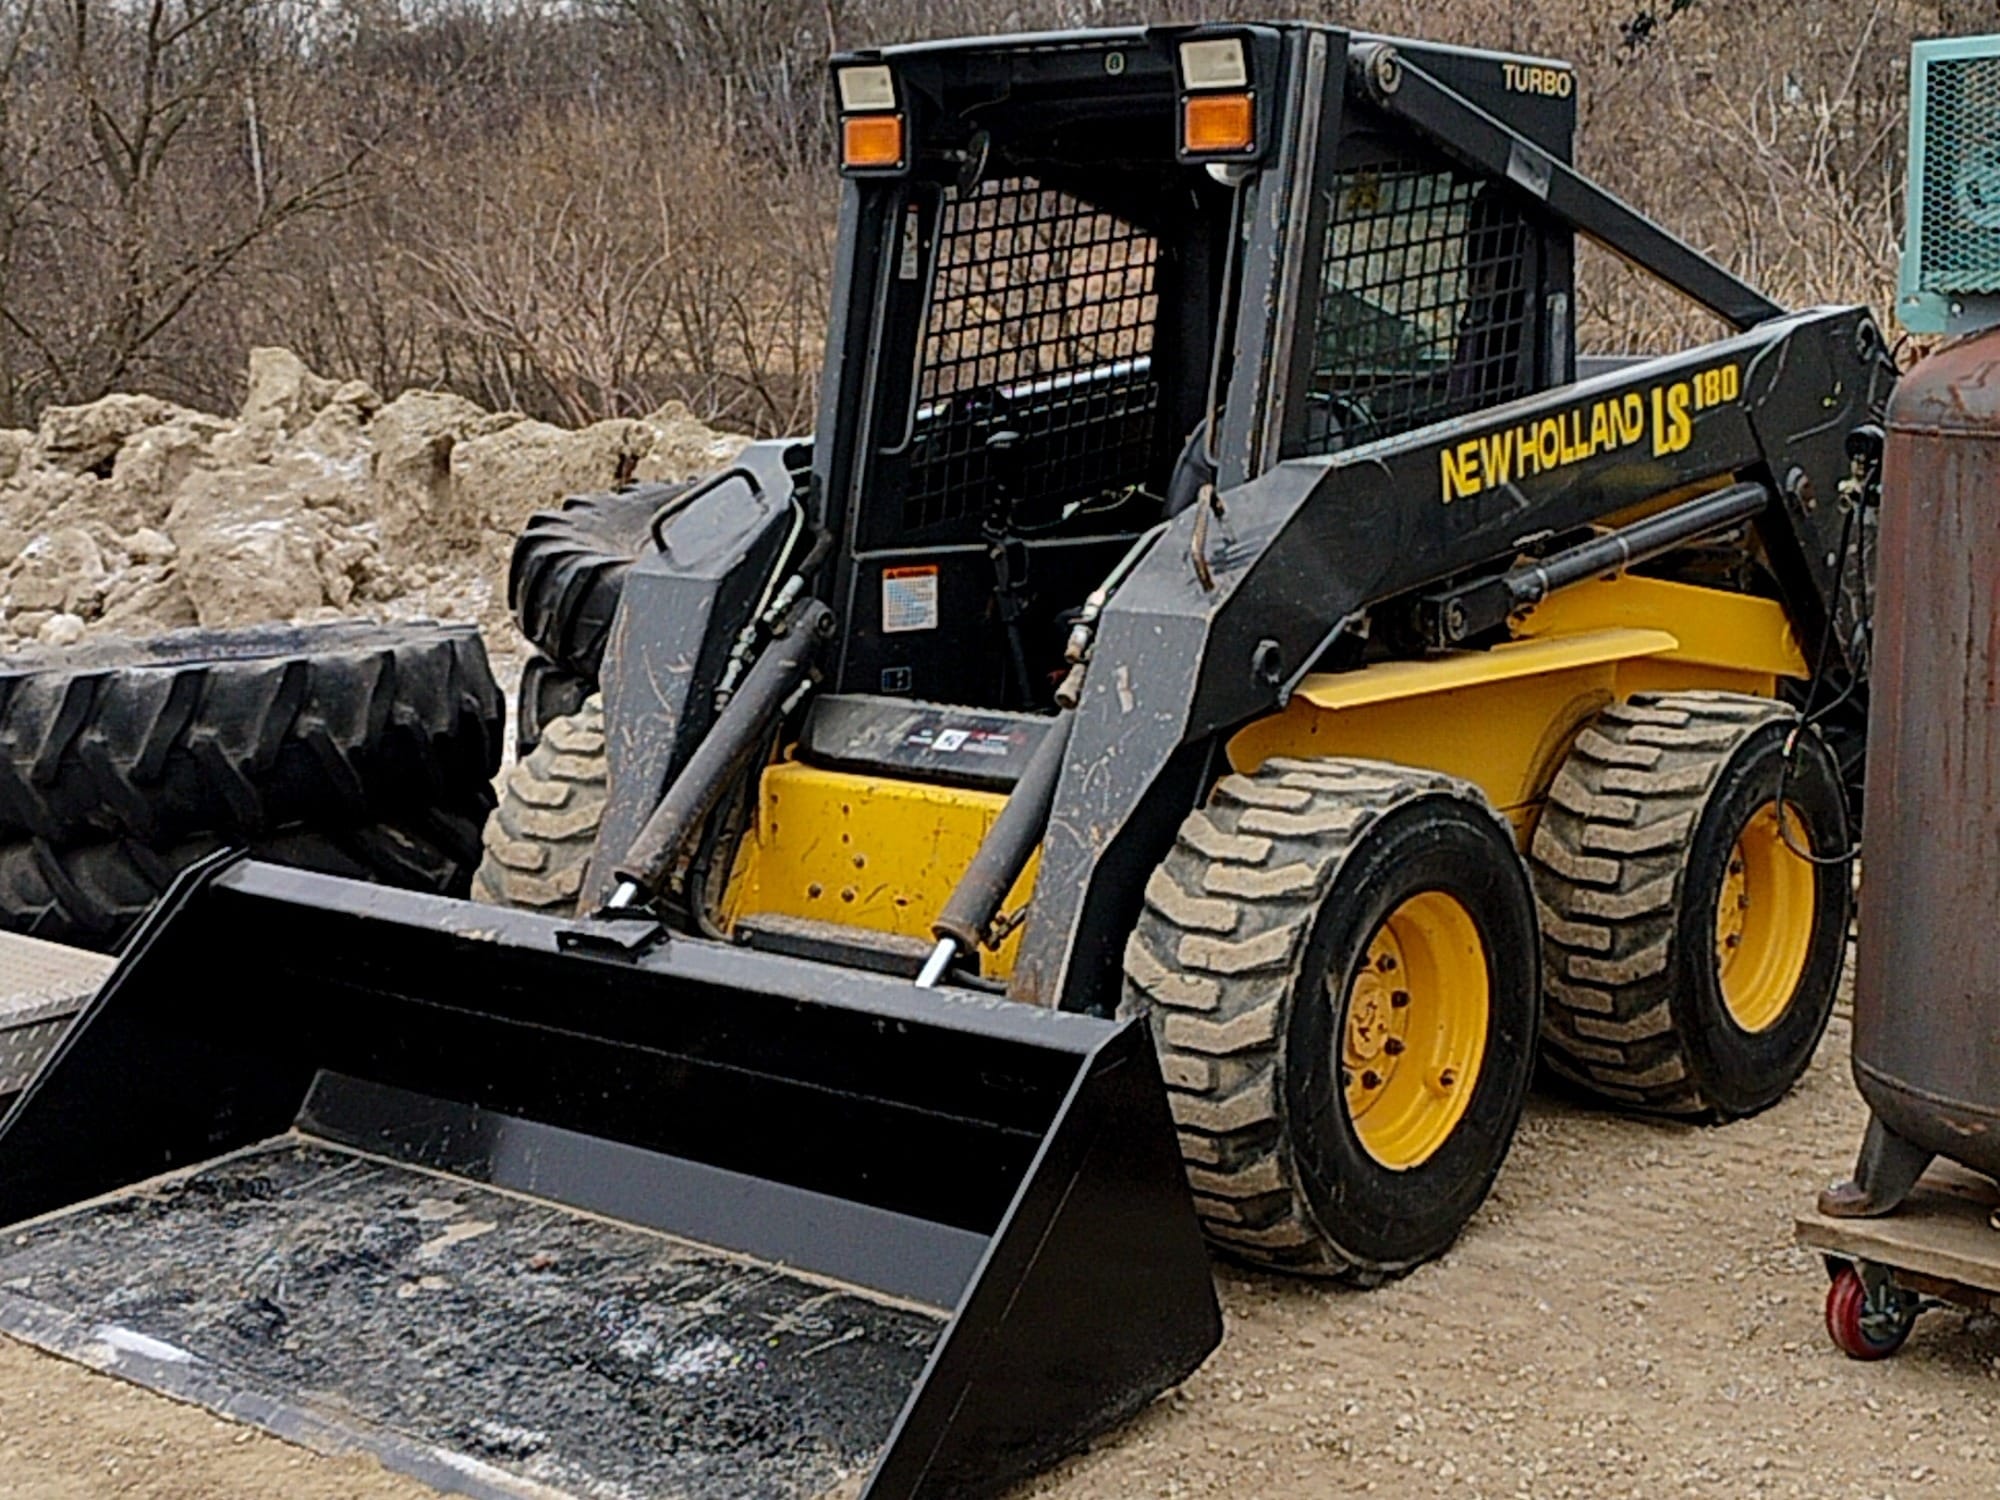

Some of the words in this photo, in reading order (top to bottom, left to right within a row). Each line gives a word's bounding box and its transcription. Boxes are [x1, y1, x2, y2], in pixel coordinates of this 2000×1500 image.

[1502, 64, 1572, 97] TURBO
[1652, 382, 1693, 457] LS
[1693, 364, 1740, 411] 180
